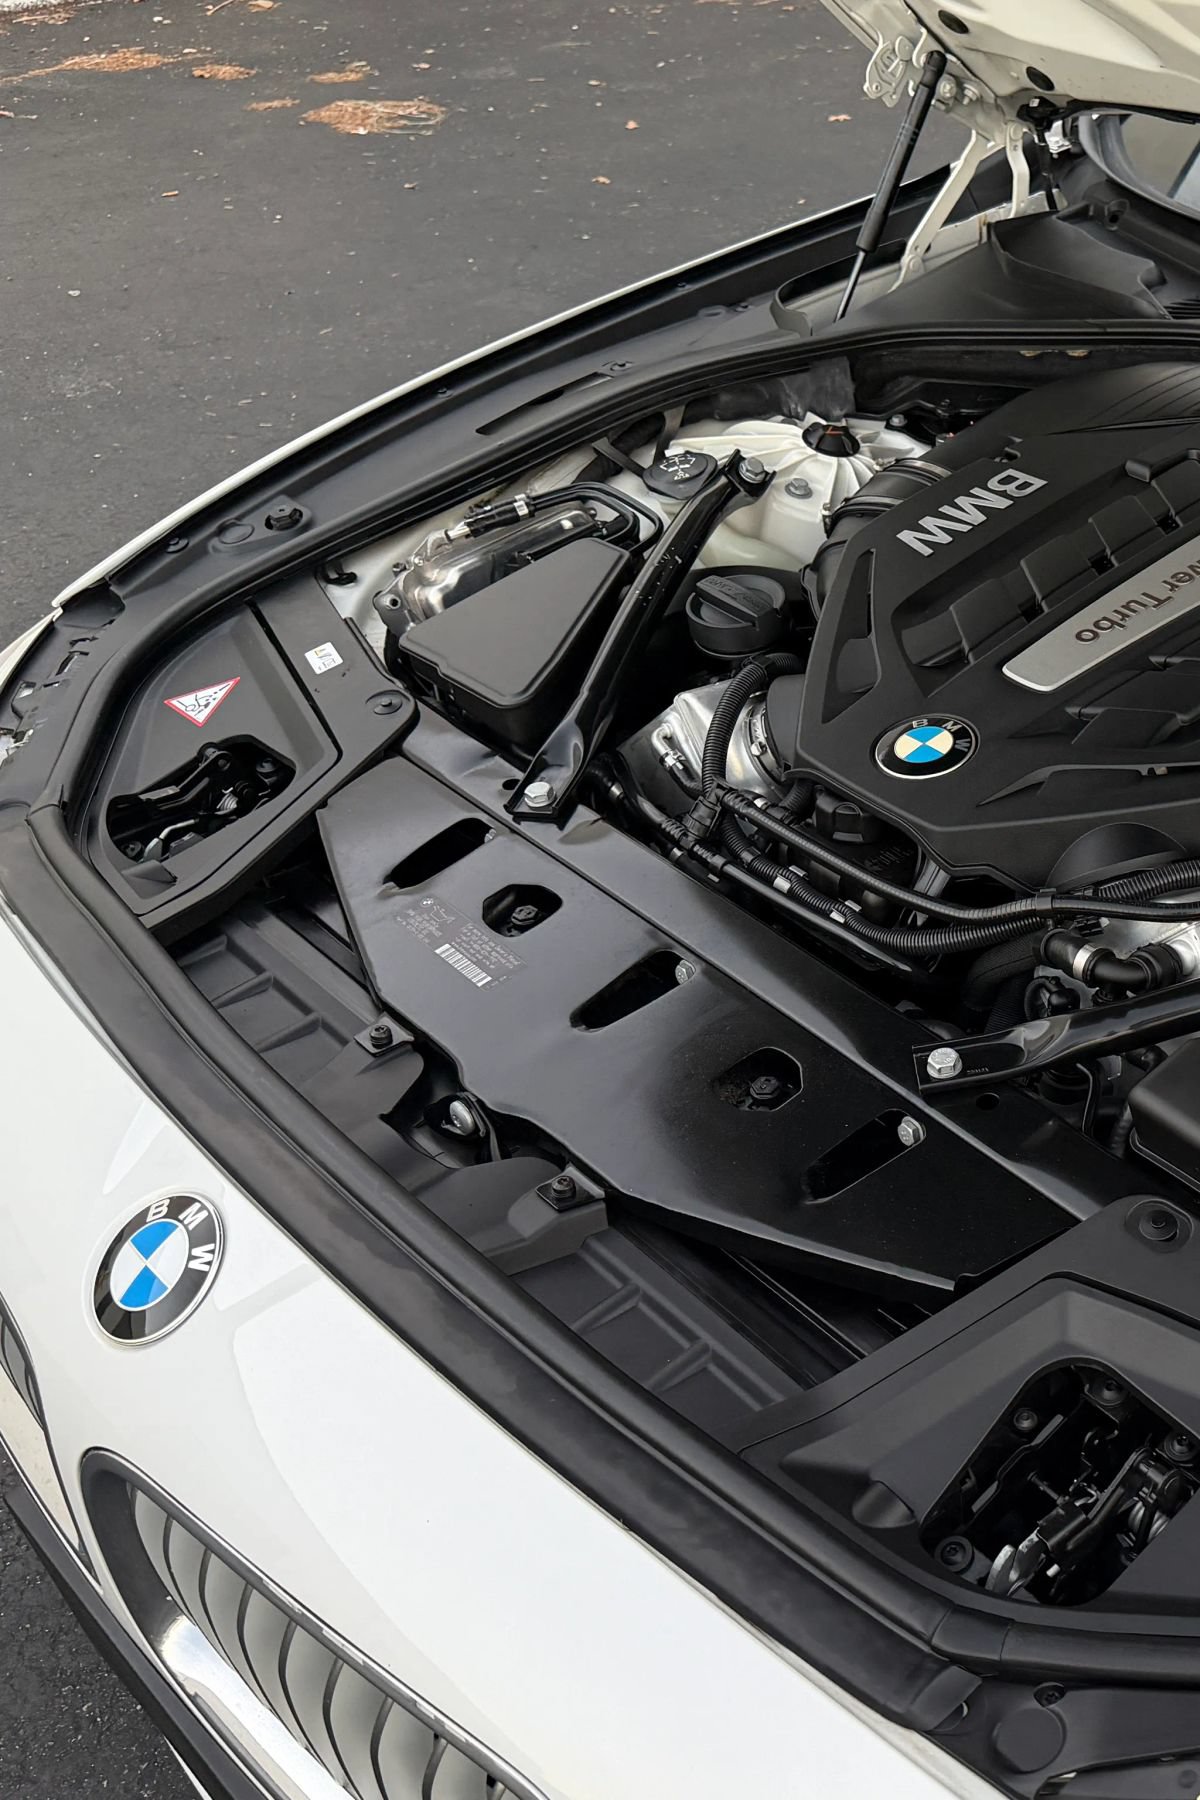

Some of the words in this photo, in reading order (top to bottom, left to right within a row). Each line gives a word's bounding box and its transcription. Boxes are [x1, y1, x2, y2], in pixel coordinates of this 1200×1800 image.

[896, 468, 1048, 557] BMW
[1074, 591, 1175, 643] Turbo
[912, 718, 971, 752] BMW
[146, 1198, 215, 1272] BMW
